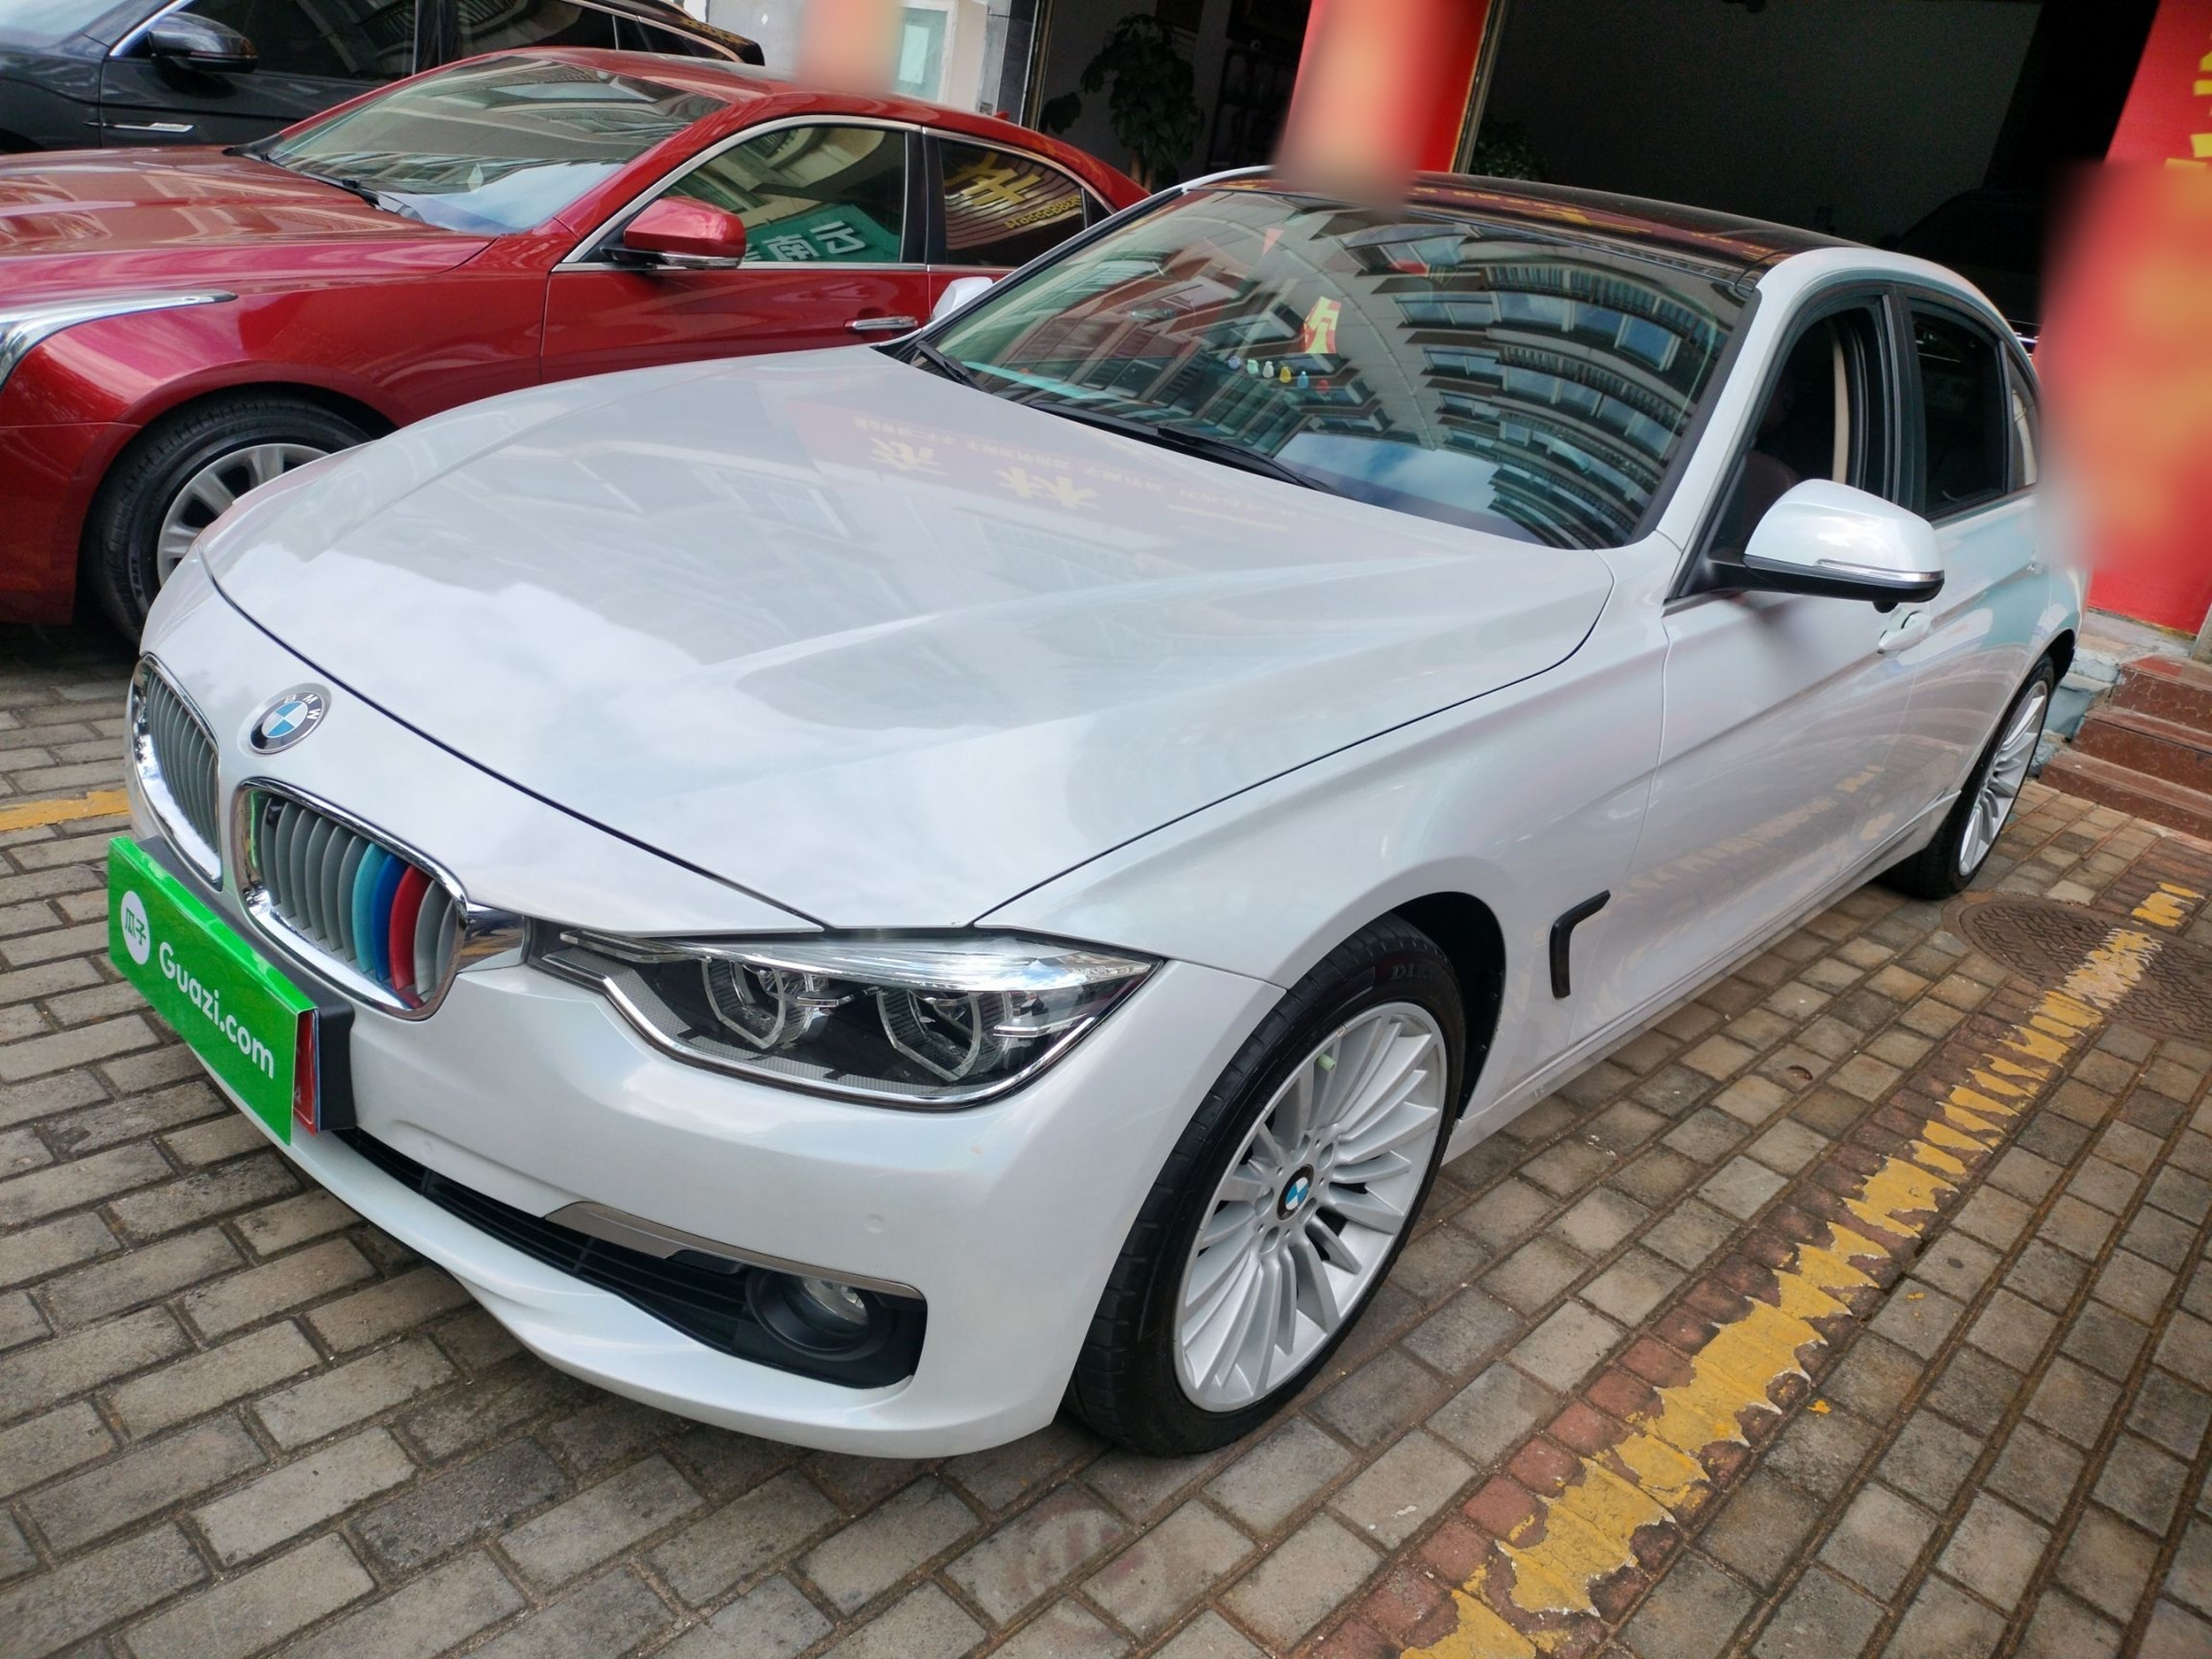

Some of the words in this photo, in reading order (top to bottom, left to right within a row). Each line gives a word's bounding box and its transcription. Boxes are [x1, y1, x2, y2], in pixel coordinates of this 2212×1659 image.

[284, 694, 321, 719] BMW
[126, 907, 147, 946] 瓜子
[158, 941, 274, 1080] Guazi.com
